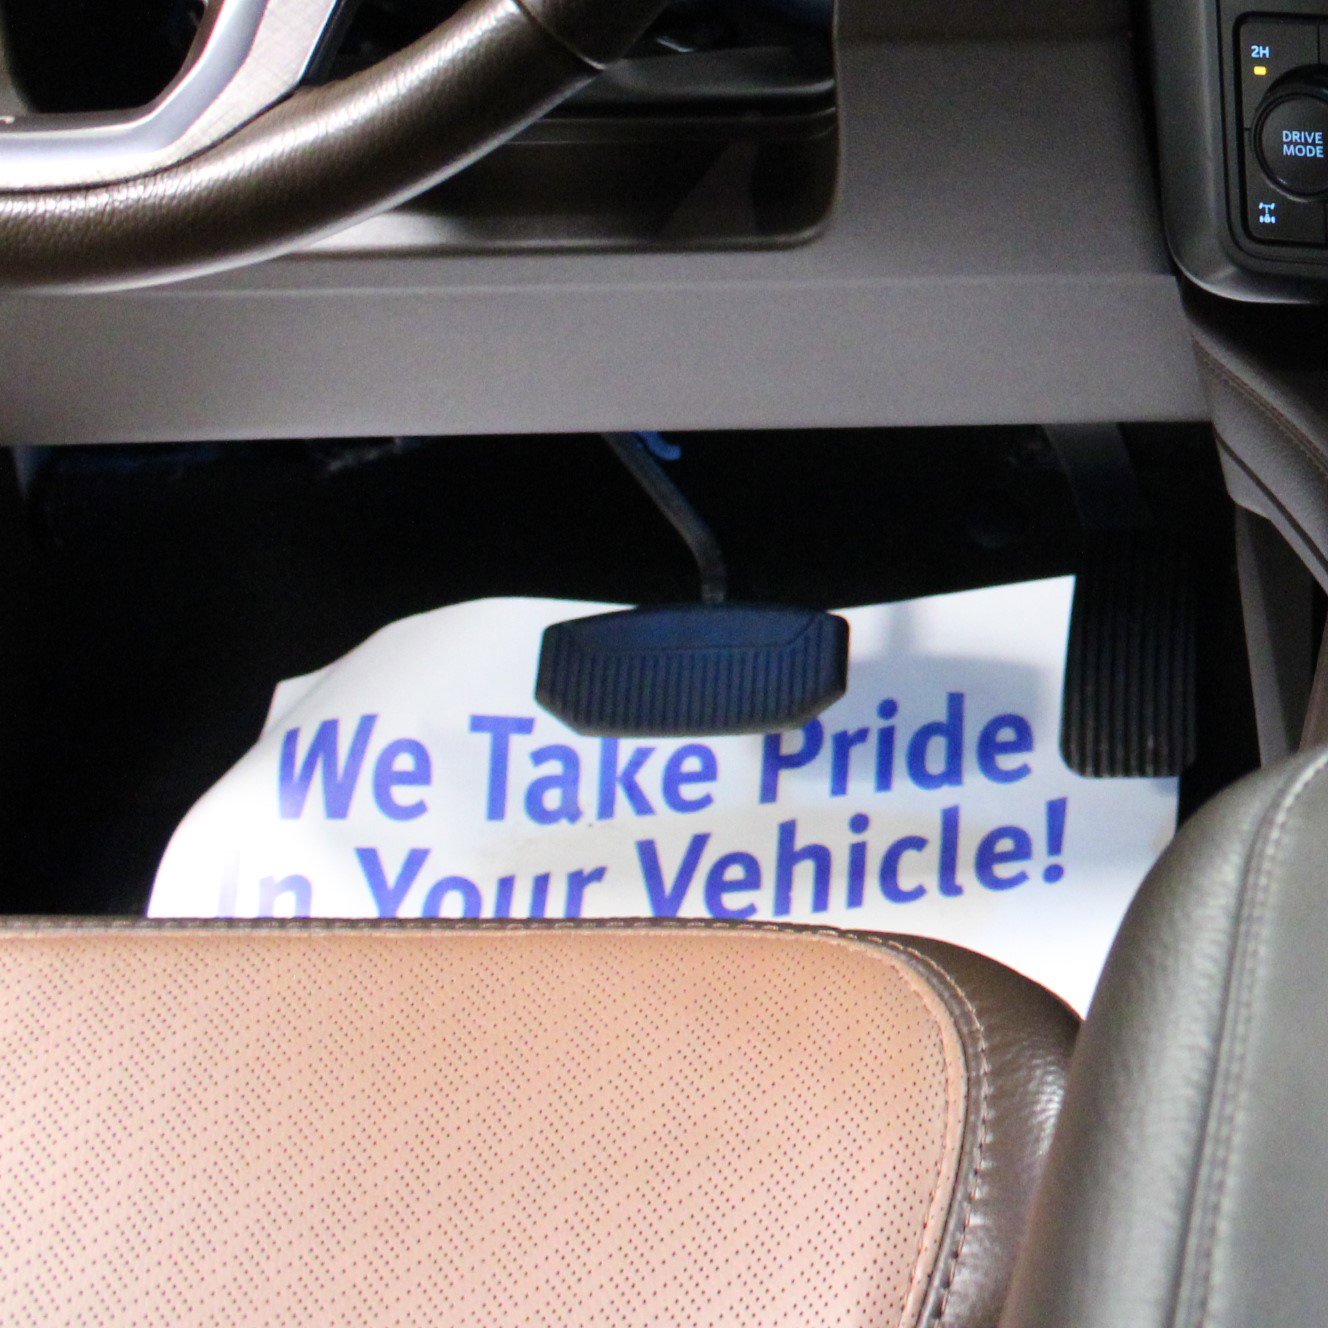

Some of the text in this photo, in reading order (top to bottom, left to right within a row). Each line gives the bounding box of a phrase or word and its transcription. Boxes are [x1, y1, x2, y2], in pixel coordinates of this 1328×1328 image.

[1251, 45, 1270, 59] 2H
[1282, 130, 1323, 145] DRIVE
[1282, 144, 1325, 158] MODE
[276, 692, 1036, 825] We Take Pride
[635, 797, 1069, 919] Vehicle!
